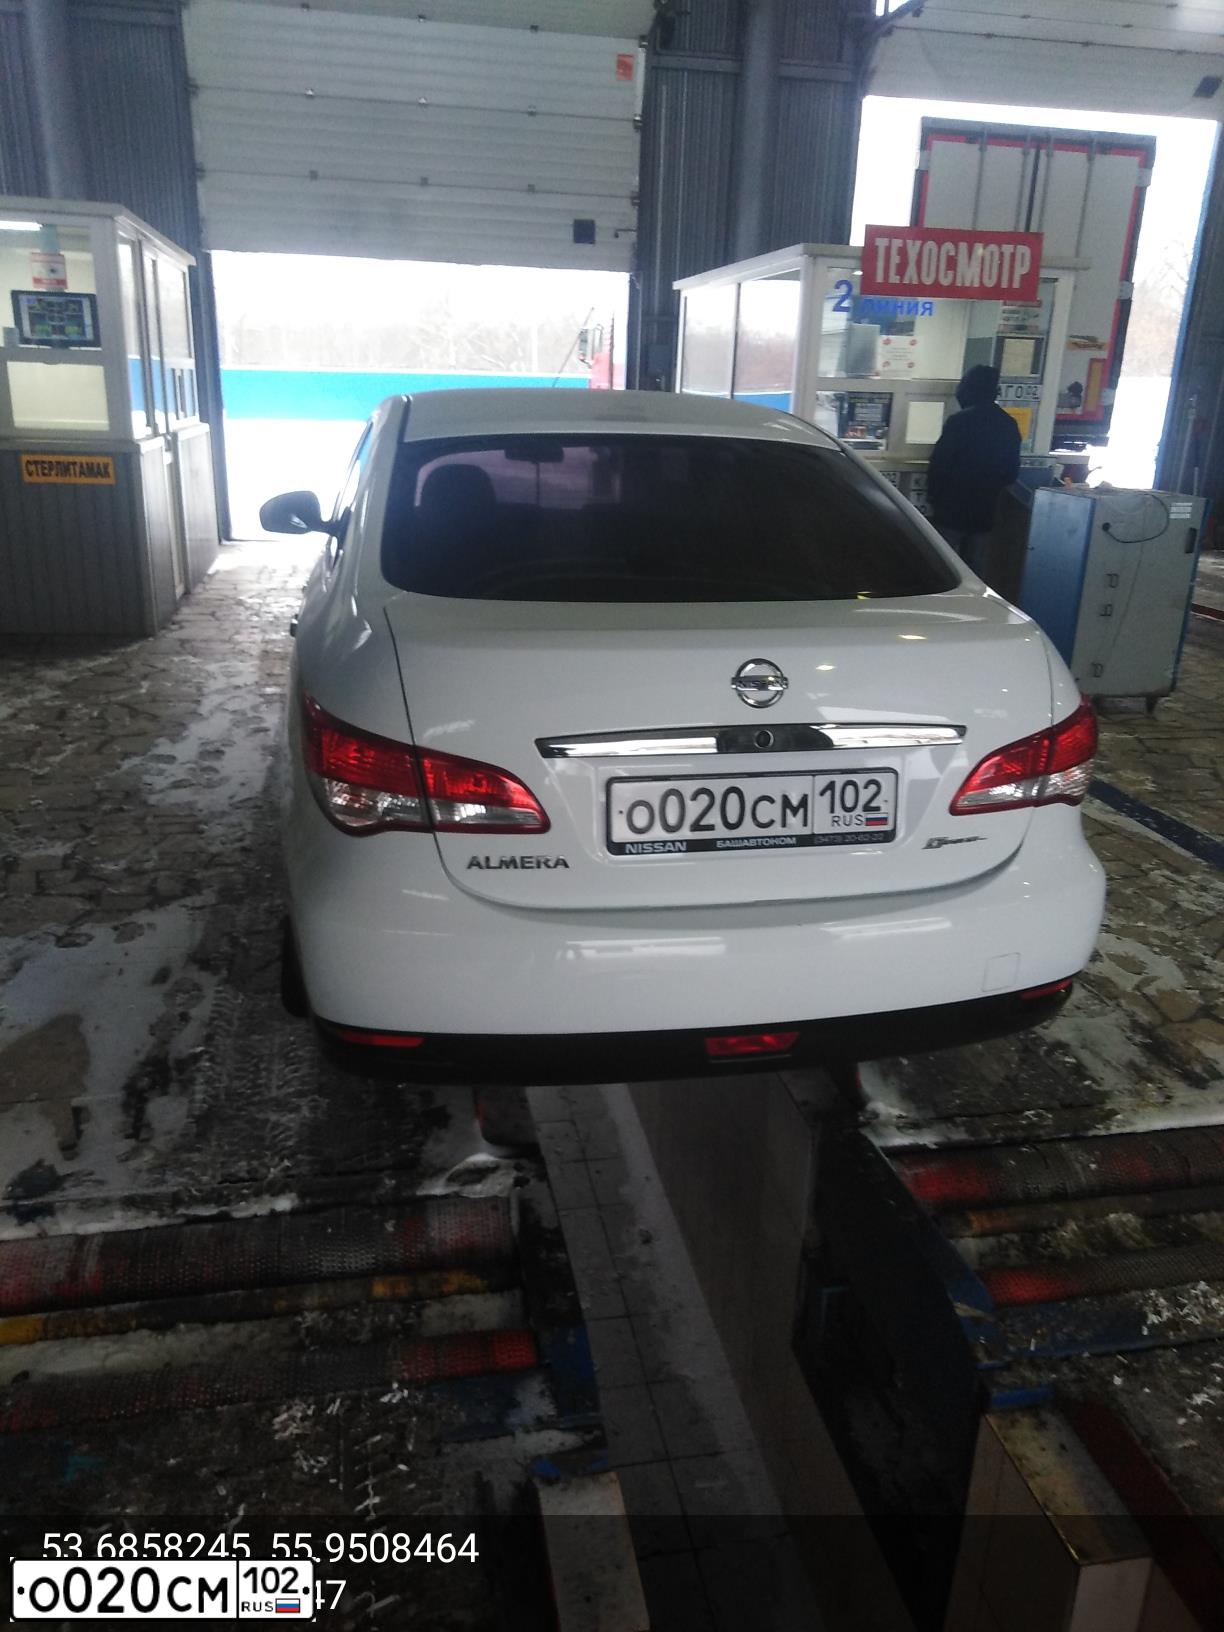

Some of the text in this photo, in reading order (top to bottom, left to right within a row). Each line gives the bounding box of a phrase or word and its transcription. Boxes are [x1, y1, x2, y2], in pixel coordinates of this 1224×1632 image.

[874, 237, 1032, 289] ТЕХОСМОТР
[832, 279, 853, 312] 2
[25, 460, 112, 479] СТЕРЛИТАМАК
[819, 779, 882, 813] 102
[831, 815, 864, 827] RUS
[625, 842, 687, 854] NISSAN
[716, 836, 797, 848] БАШАВТОКОМ
[466, 855, 570, 870] ALMERA
